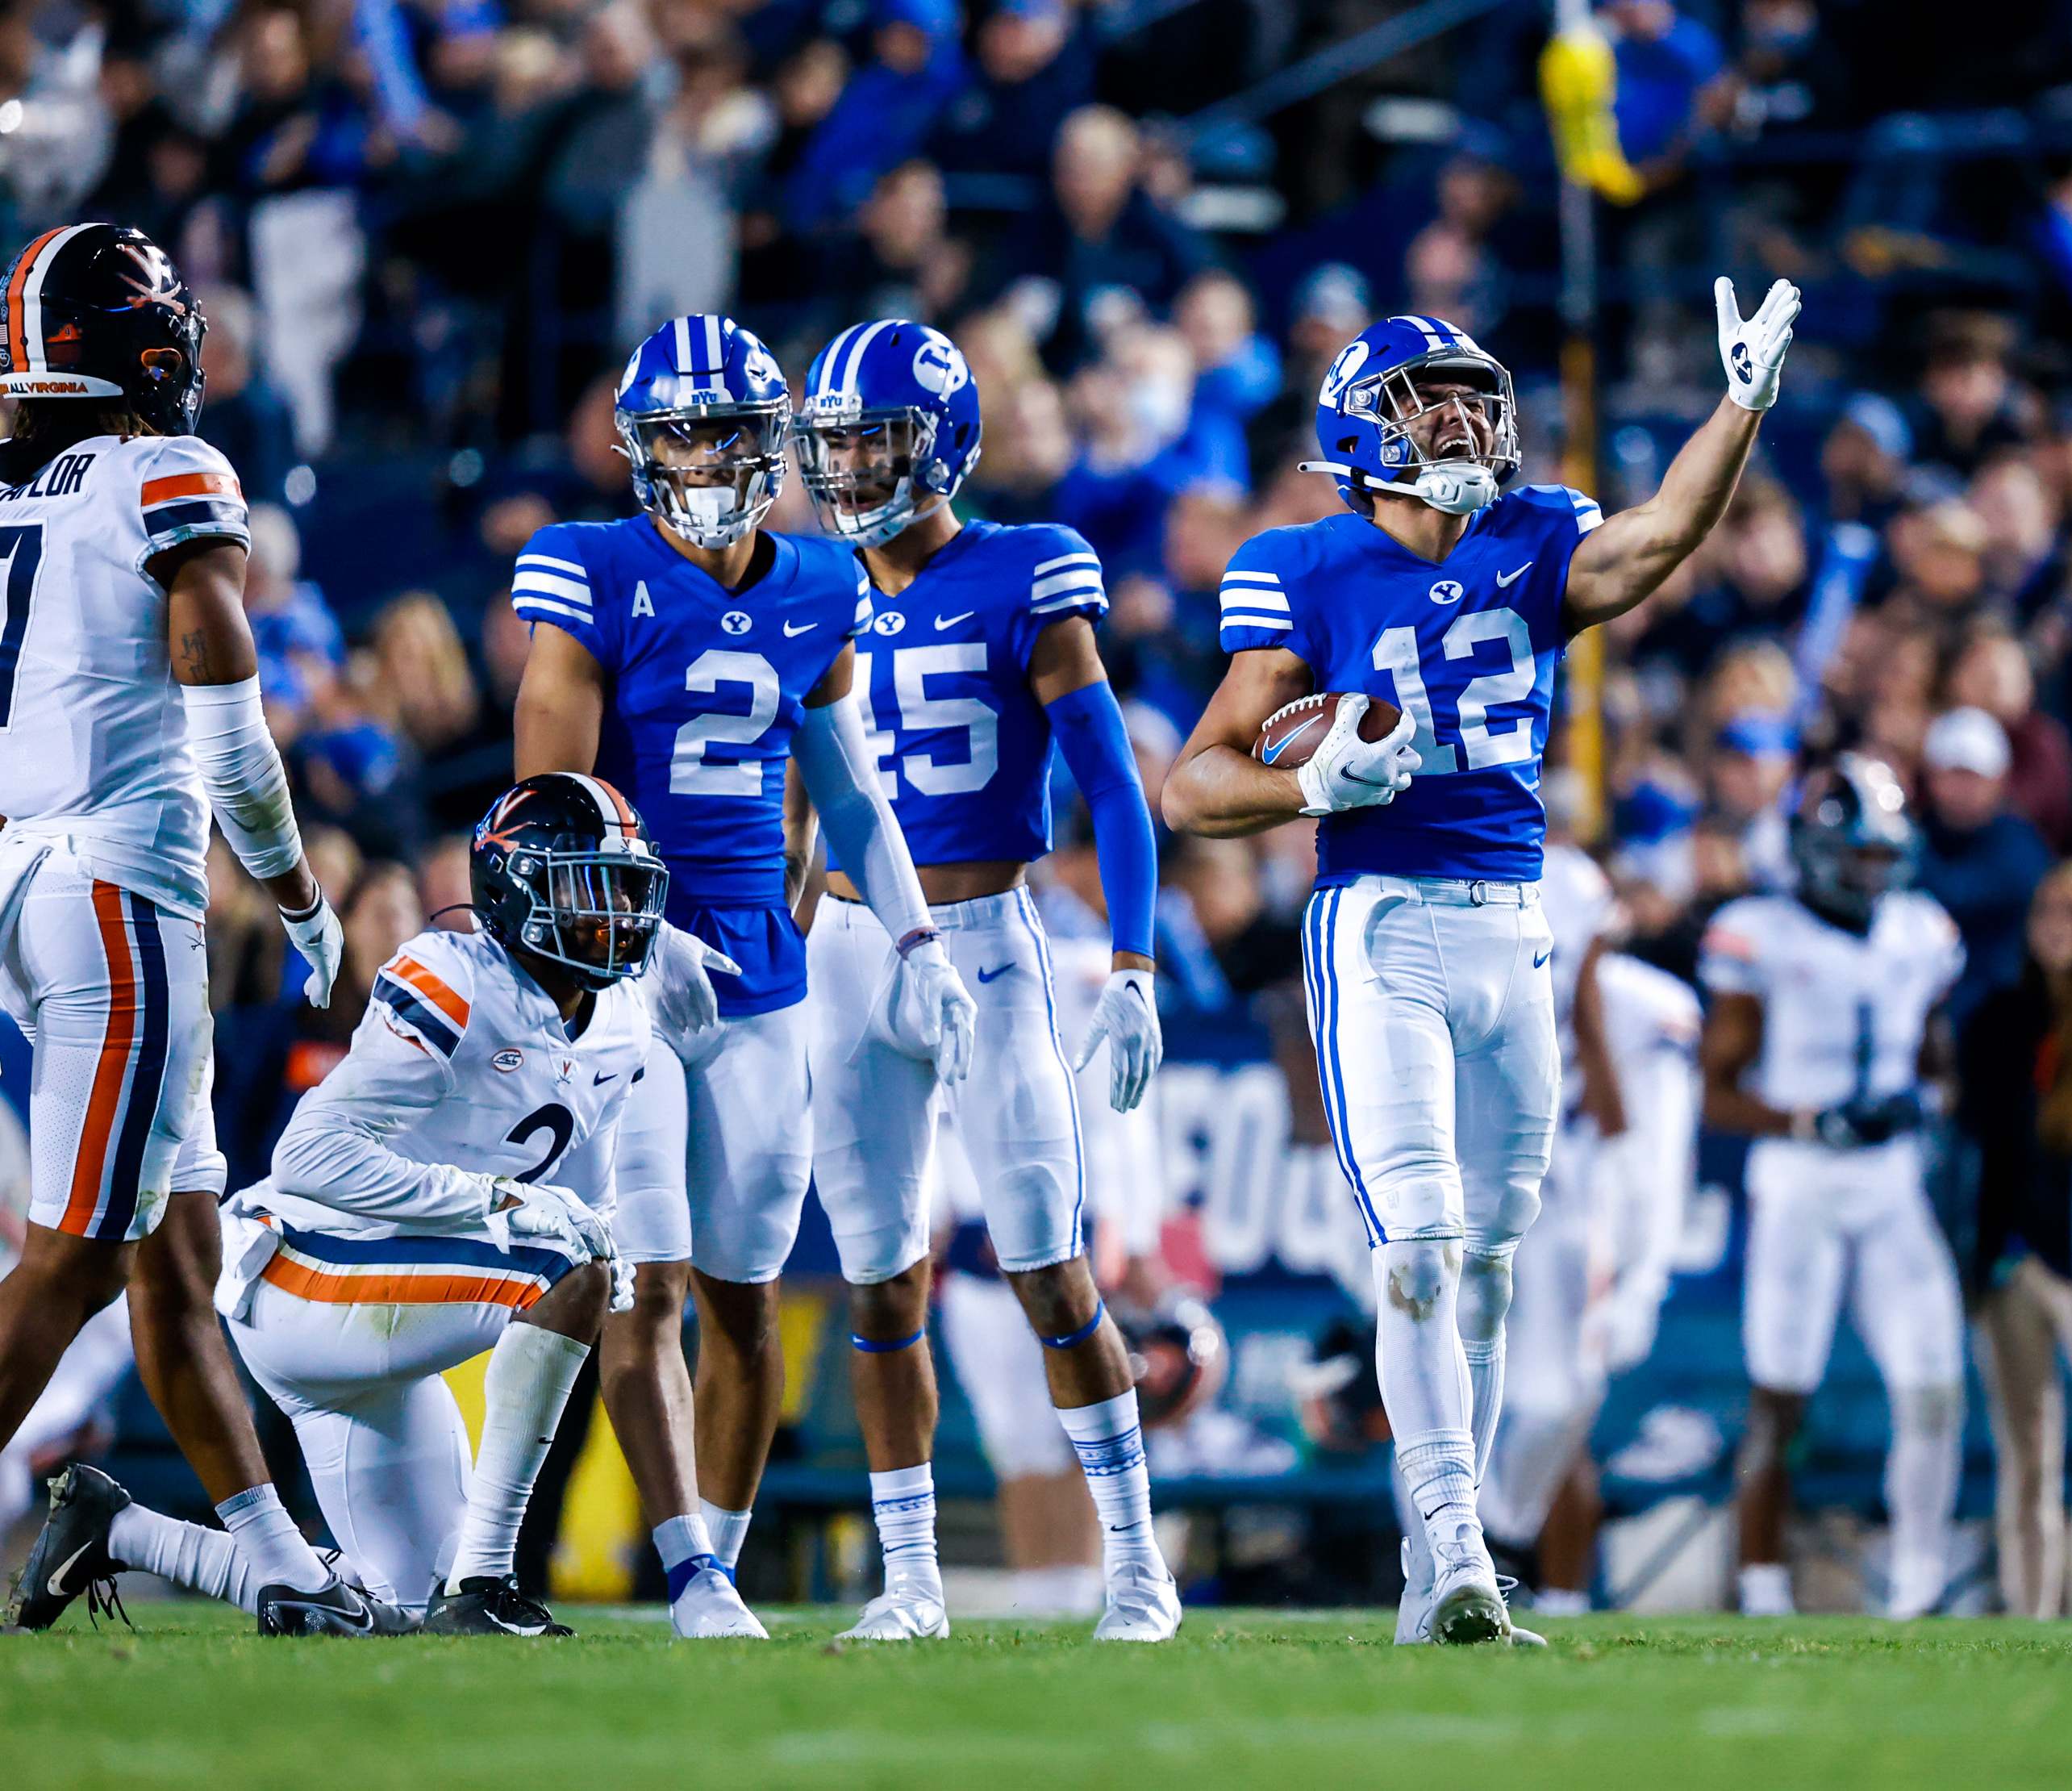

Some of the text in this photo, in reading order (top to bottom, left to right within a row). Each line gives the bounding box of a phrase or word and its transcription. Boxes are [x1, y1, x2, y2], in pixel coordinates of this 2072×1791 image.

[691, 391, 717, 404] BYU
[820, 395, 842, 408] BYU
[632, 580, 655, 617] A
[1434, 583, 1456, 601] Y
[725, 615, 747, 632] Y
[880, 616, 900, 632] Y
[1372, 607, 1536, 776] 12
[669, 649, 780, 796] 2
[506, 1103, 574, 1184] 2
